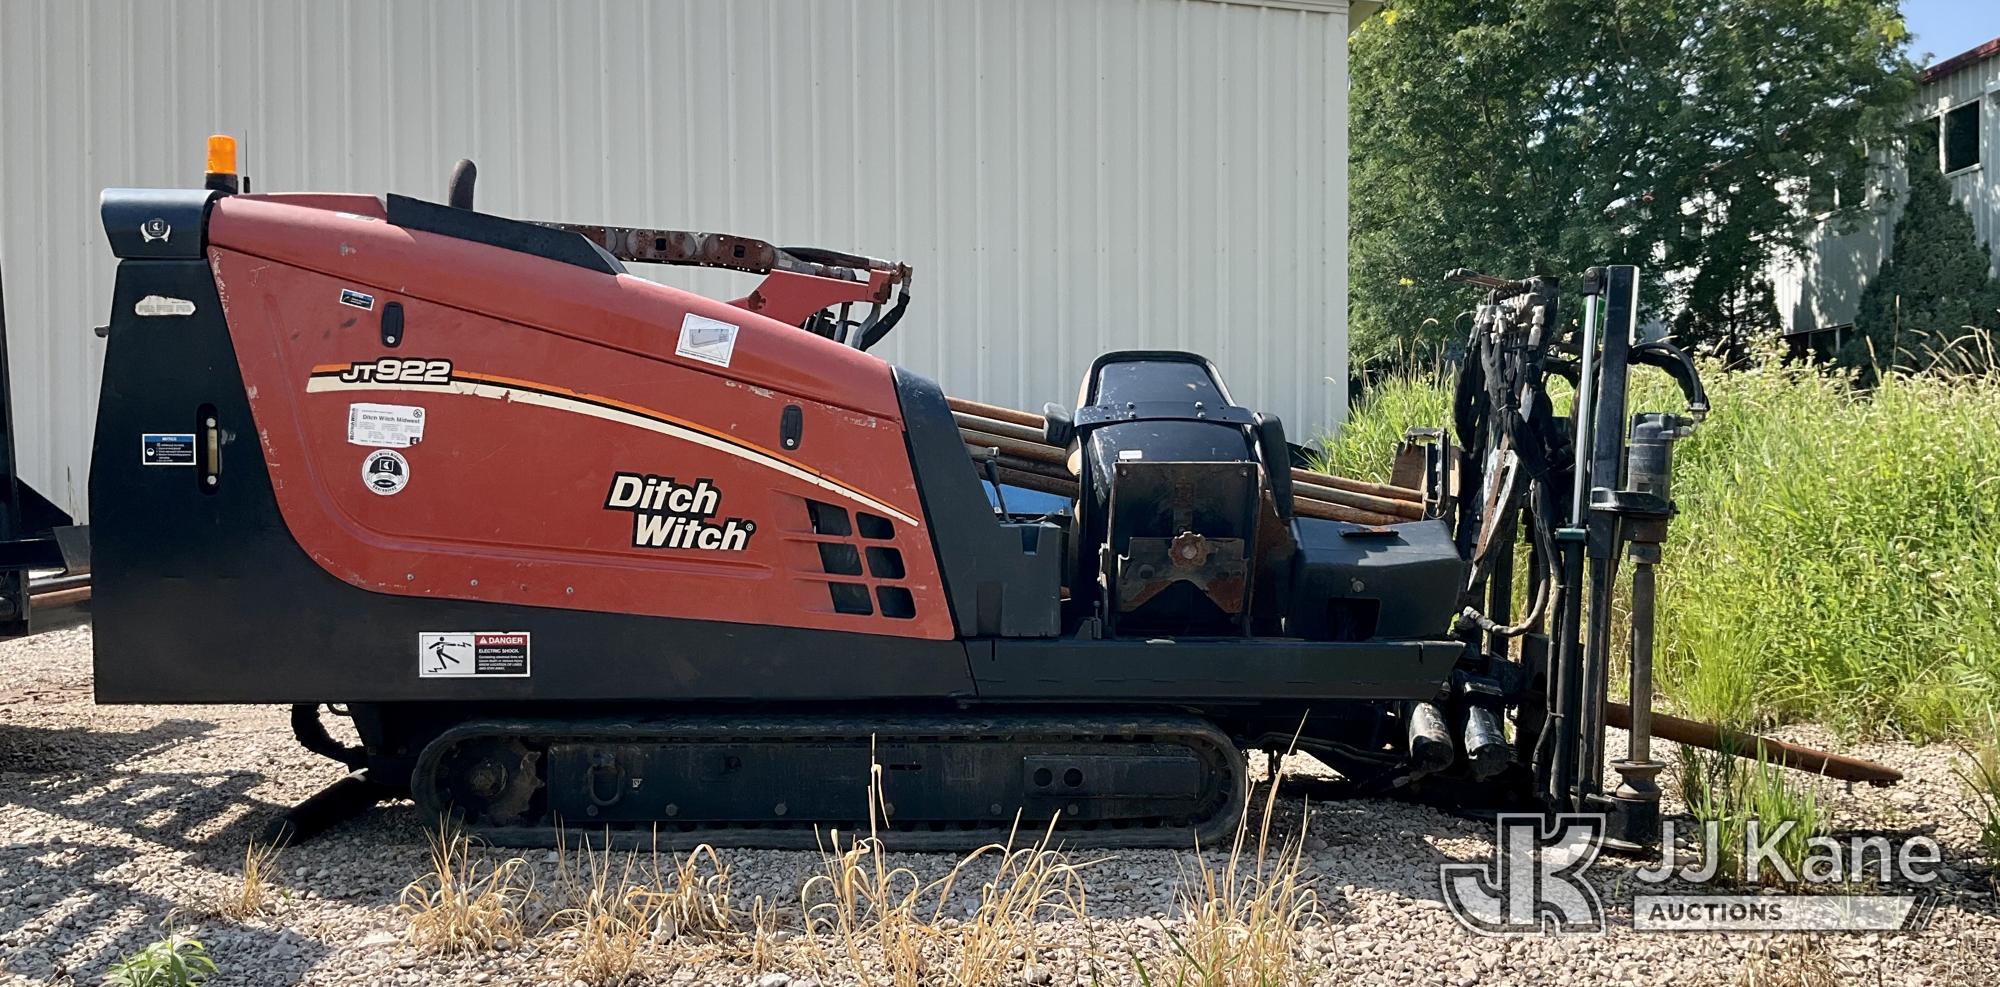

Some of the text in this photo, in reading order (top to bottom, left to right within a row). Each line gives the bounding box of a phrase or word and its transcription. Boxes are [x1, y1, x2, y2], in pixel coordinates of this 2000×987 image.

[341, 359, 451, 382] JT922
[608, 475, 718, 515] Ditch
[488, 636, 523, 644] DANGER
